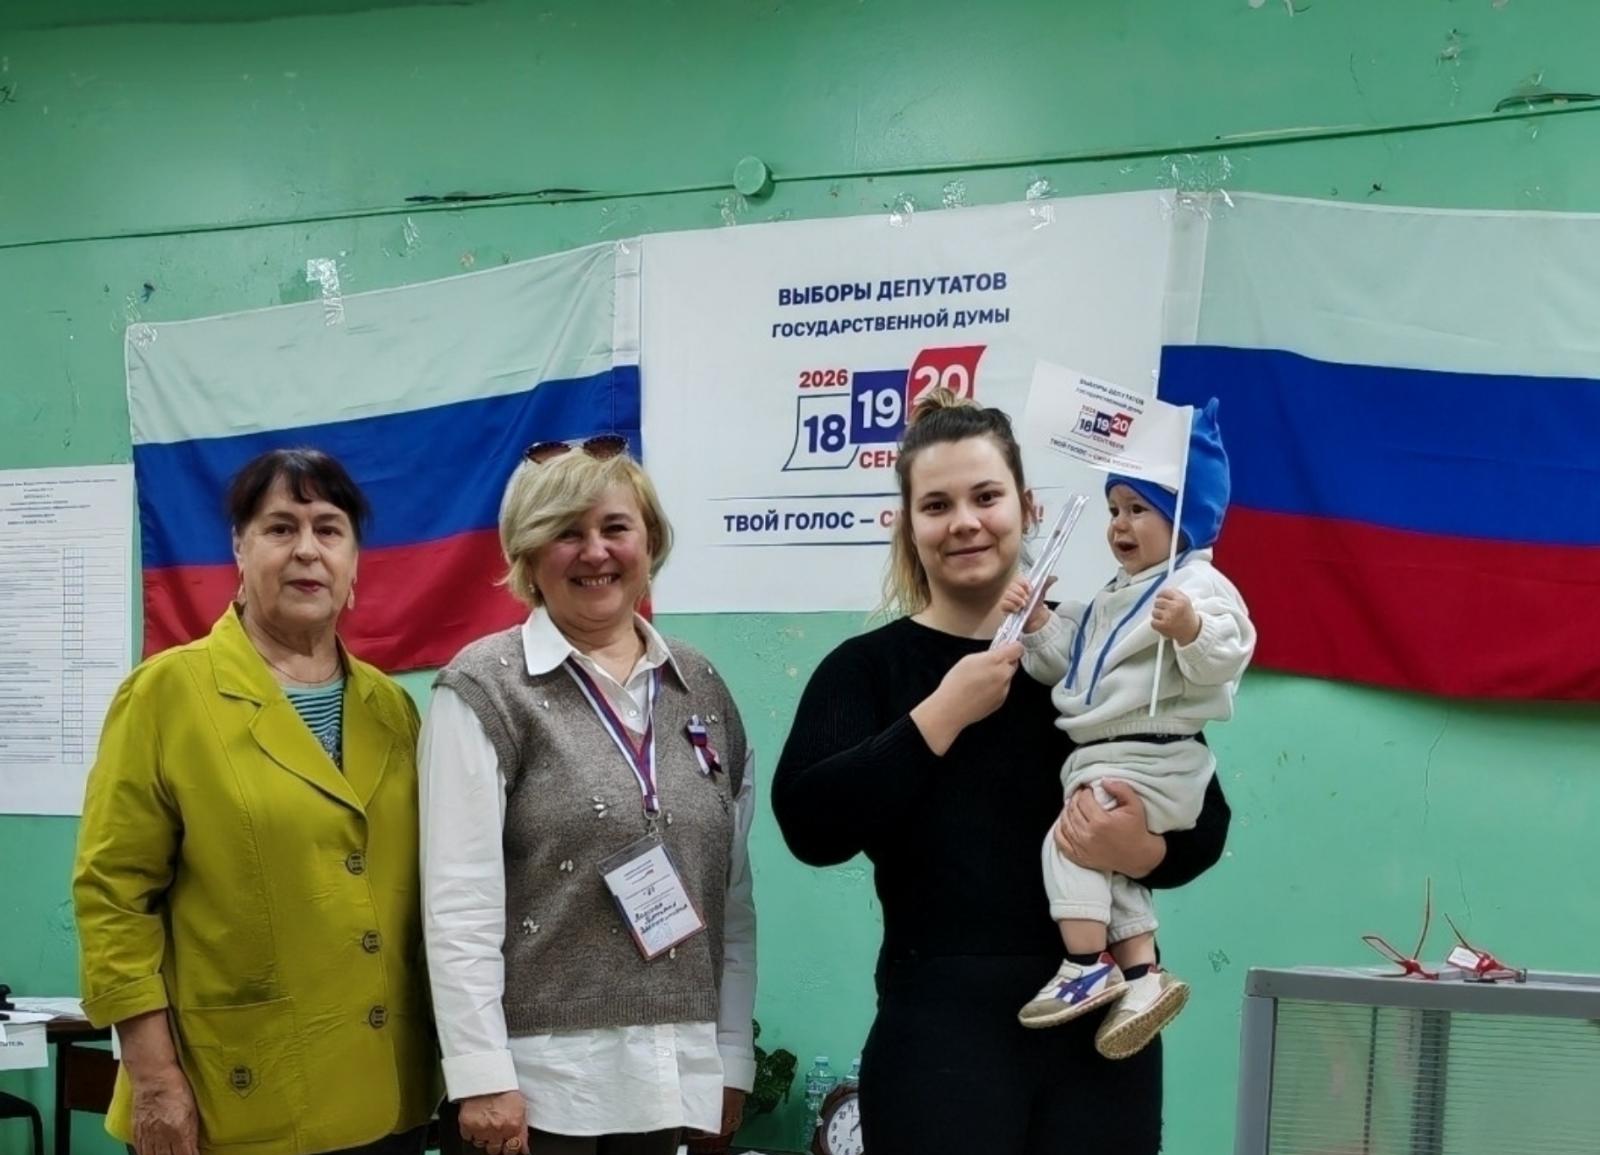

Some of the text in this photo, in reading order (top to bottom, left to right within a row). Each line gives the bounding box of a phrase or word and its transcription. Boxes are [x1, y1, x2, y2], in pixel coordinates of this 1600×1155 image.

[778, 272, 1007, 306] ВЫБОРЫ ДЕПУТАТОВ
[772, 308, 1010, 338] ГОСУДАРСТВЕННОЙ ДУМЫ
[799, 369, 848, 388] 2026
[913, 364, 969, 406] 20
[857, 388, 901, 428] 19
[804, 414, 846, 453] 18
[1080, 418, 1093, 432] 18
[1097, 416, 1109, 431] 19
[1112, 416, 1129, 433] 20
[723, 509, 779, 532] ТВОЙ
[785, 511, 854, 530] ГОЛОС
